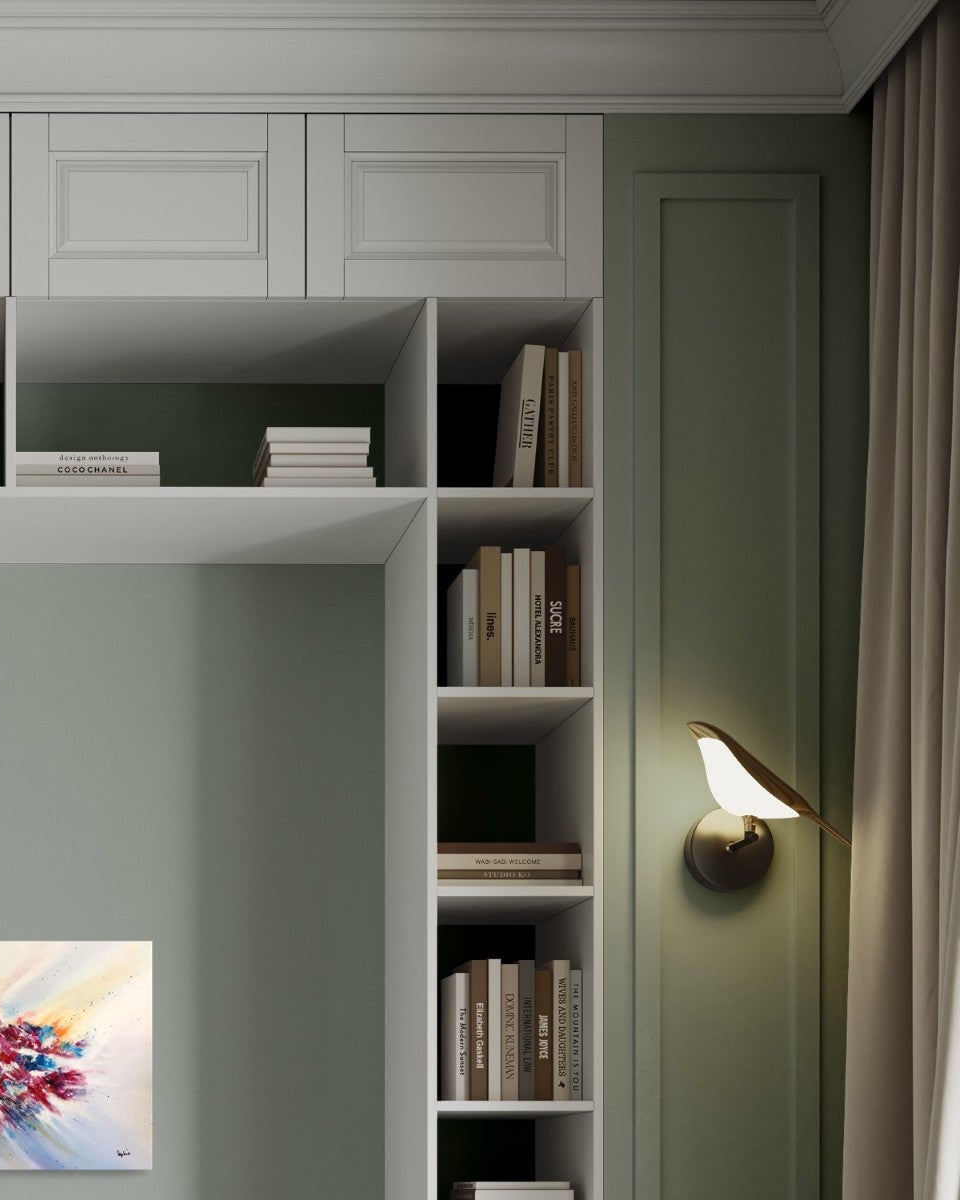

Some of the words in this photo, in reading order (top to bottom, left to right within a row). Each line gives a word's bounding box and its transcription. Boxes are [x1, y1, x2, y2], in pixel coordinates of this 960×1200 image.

[522, 399, 536, 448] GATHER
[486, 612, 496, 640] lines.
[550, 601, 562, 634] SUCRE
[505, 993, 514, 1032] DOMINIC
[539, 1014, 548, 1036] JAMES
[505, 1035, 514, 1080] KUNEMAN
[539, 1039, 548, 1059] JOYCE
